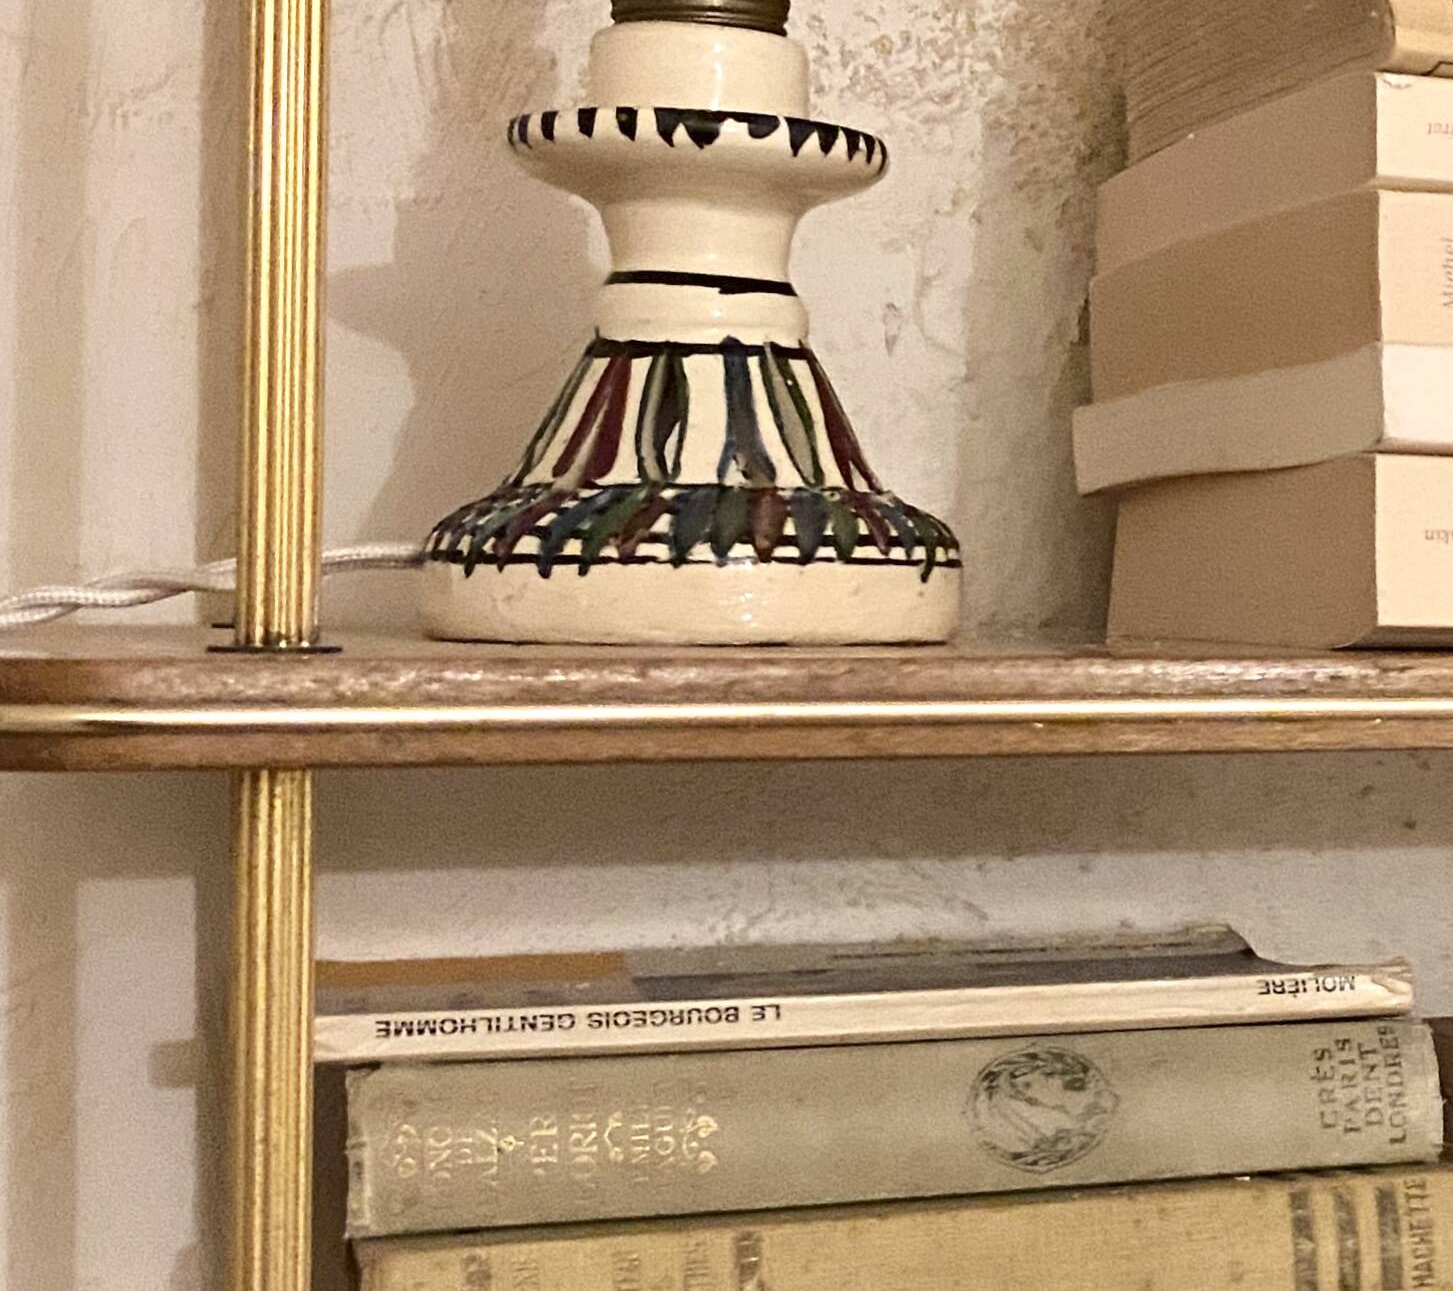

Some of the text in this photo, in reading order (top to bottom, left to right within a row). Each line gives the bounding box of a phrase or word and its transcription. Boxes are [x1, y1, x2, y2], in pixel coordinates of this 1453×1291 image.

[375, 1003, 782, 1039] LE BOURGEOIS GENTILHOMME
[1257, 976, 1357, 998] MOLIÈRE
[1337, 1037, 1363, 1136] PARIS
[1356, 1041, 1384, 1128] DENT
[1404, 1177, 1437, 1290] HACHETTE
